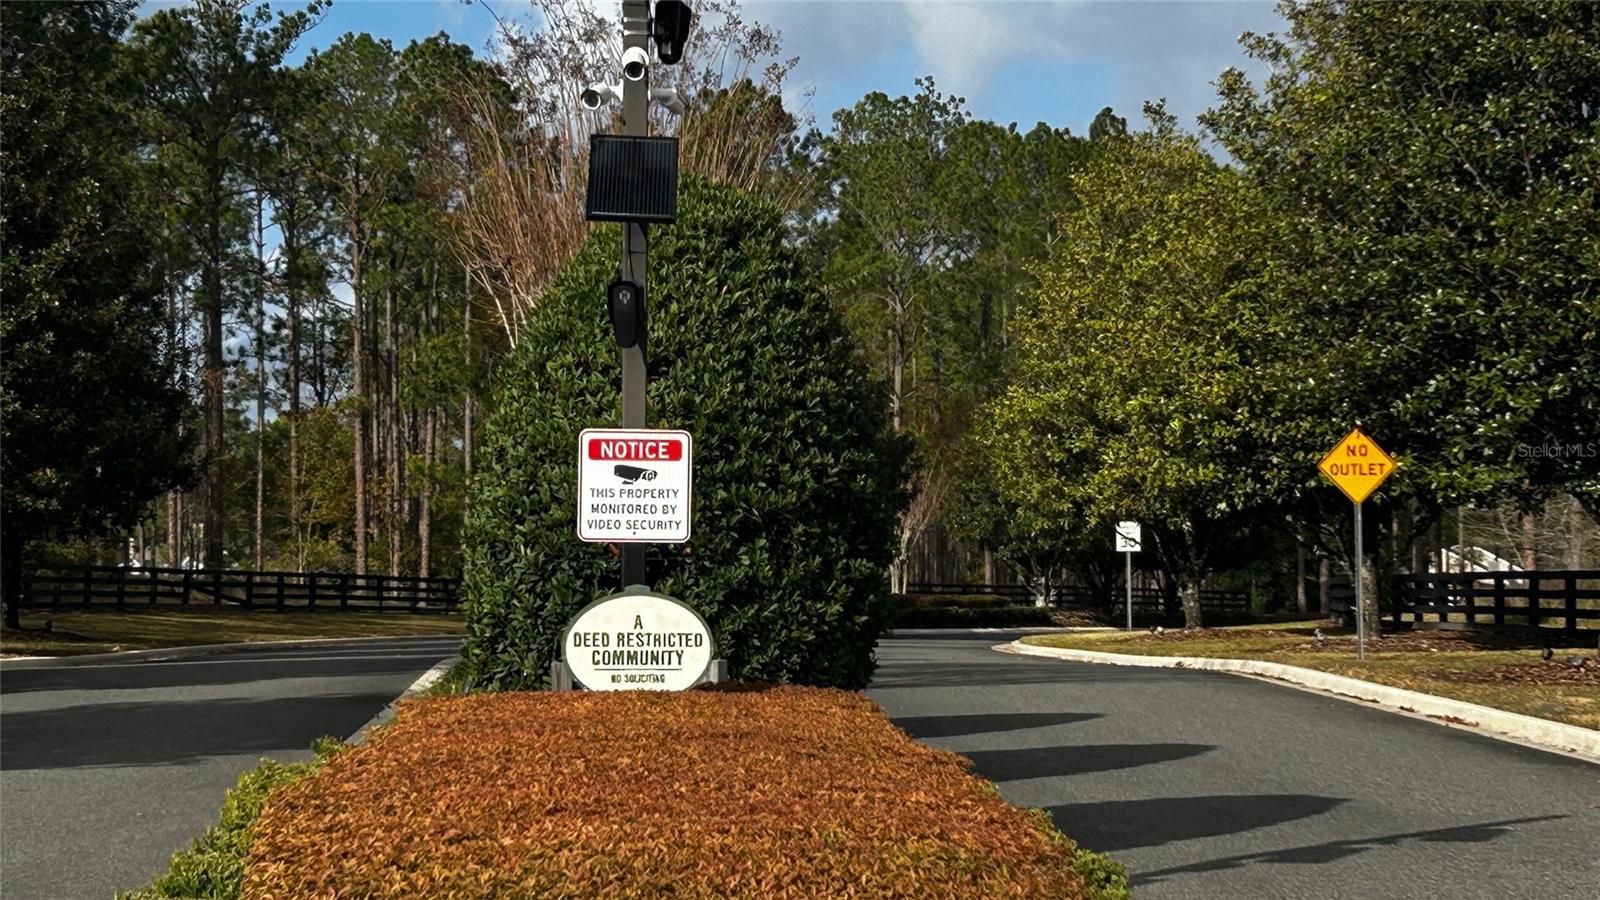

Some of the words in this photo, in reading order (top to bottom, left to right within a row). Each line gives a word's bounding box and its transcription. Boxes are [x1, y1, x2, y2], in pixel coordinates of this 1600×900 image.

[600, 441, 670, 459] NOTICE
[1346, 444, 1368, 457] NO
[1329, 463, 1386, 476] OUTLET
[589, 487, 615, 498] THIS
[619, 488, 680, 499] PROPERTY
[591, 504, 657, 514] MONITORED
[662, 504, 677, 514] BY
[587, 519, 621, 530] VIDEO
[625, 520, 682, 530] SECURITY
[634, 615, 643, 630] A
[573, 632, 610, 647] DEED
[617, 632, 703, 648] RESTRICTED
[592, 650, 684, 666] COMMUNITY
[611, 674, 621, 683] NO
